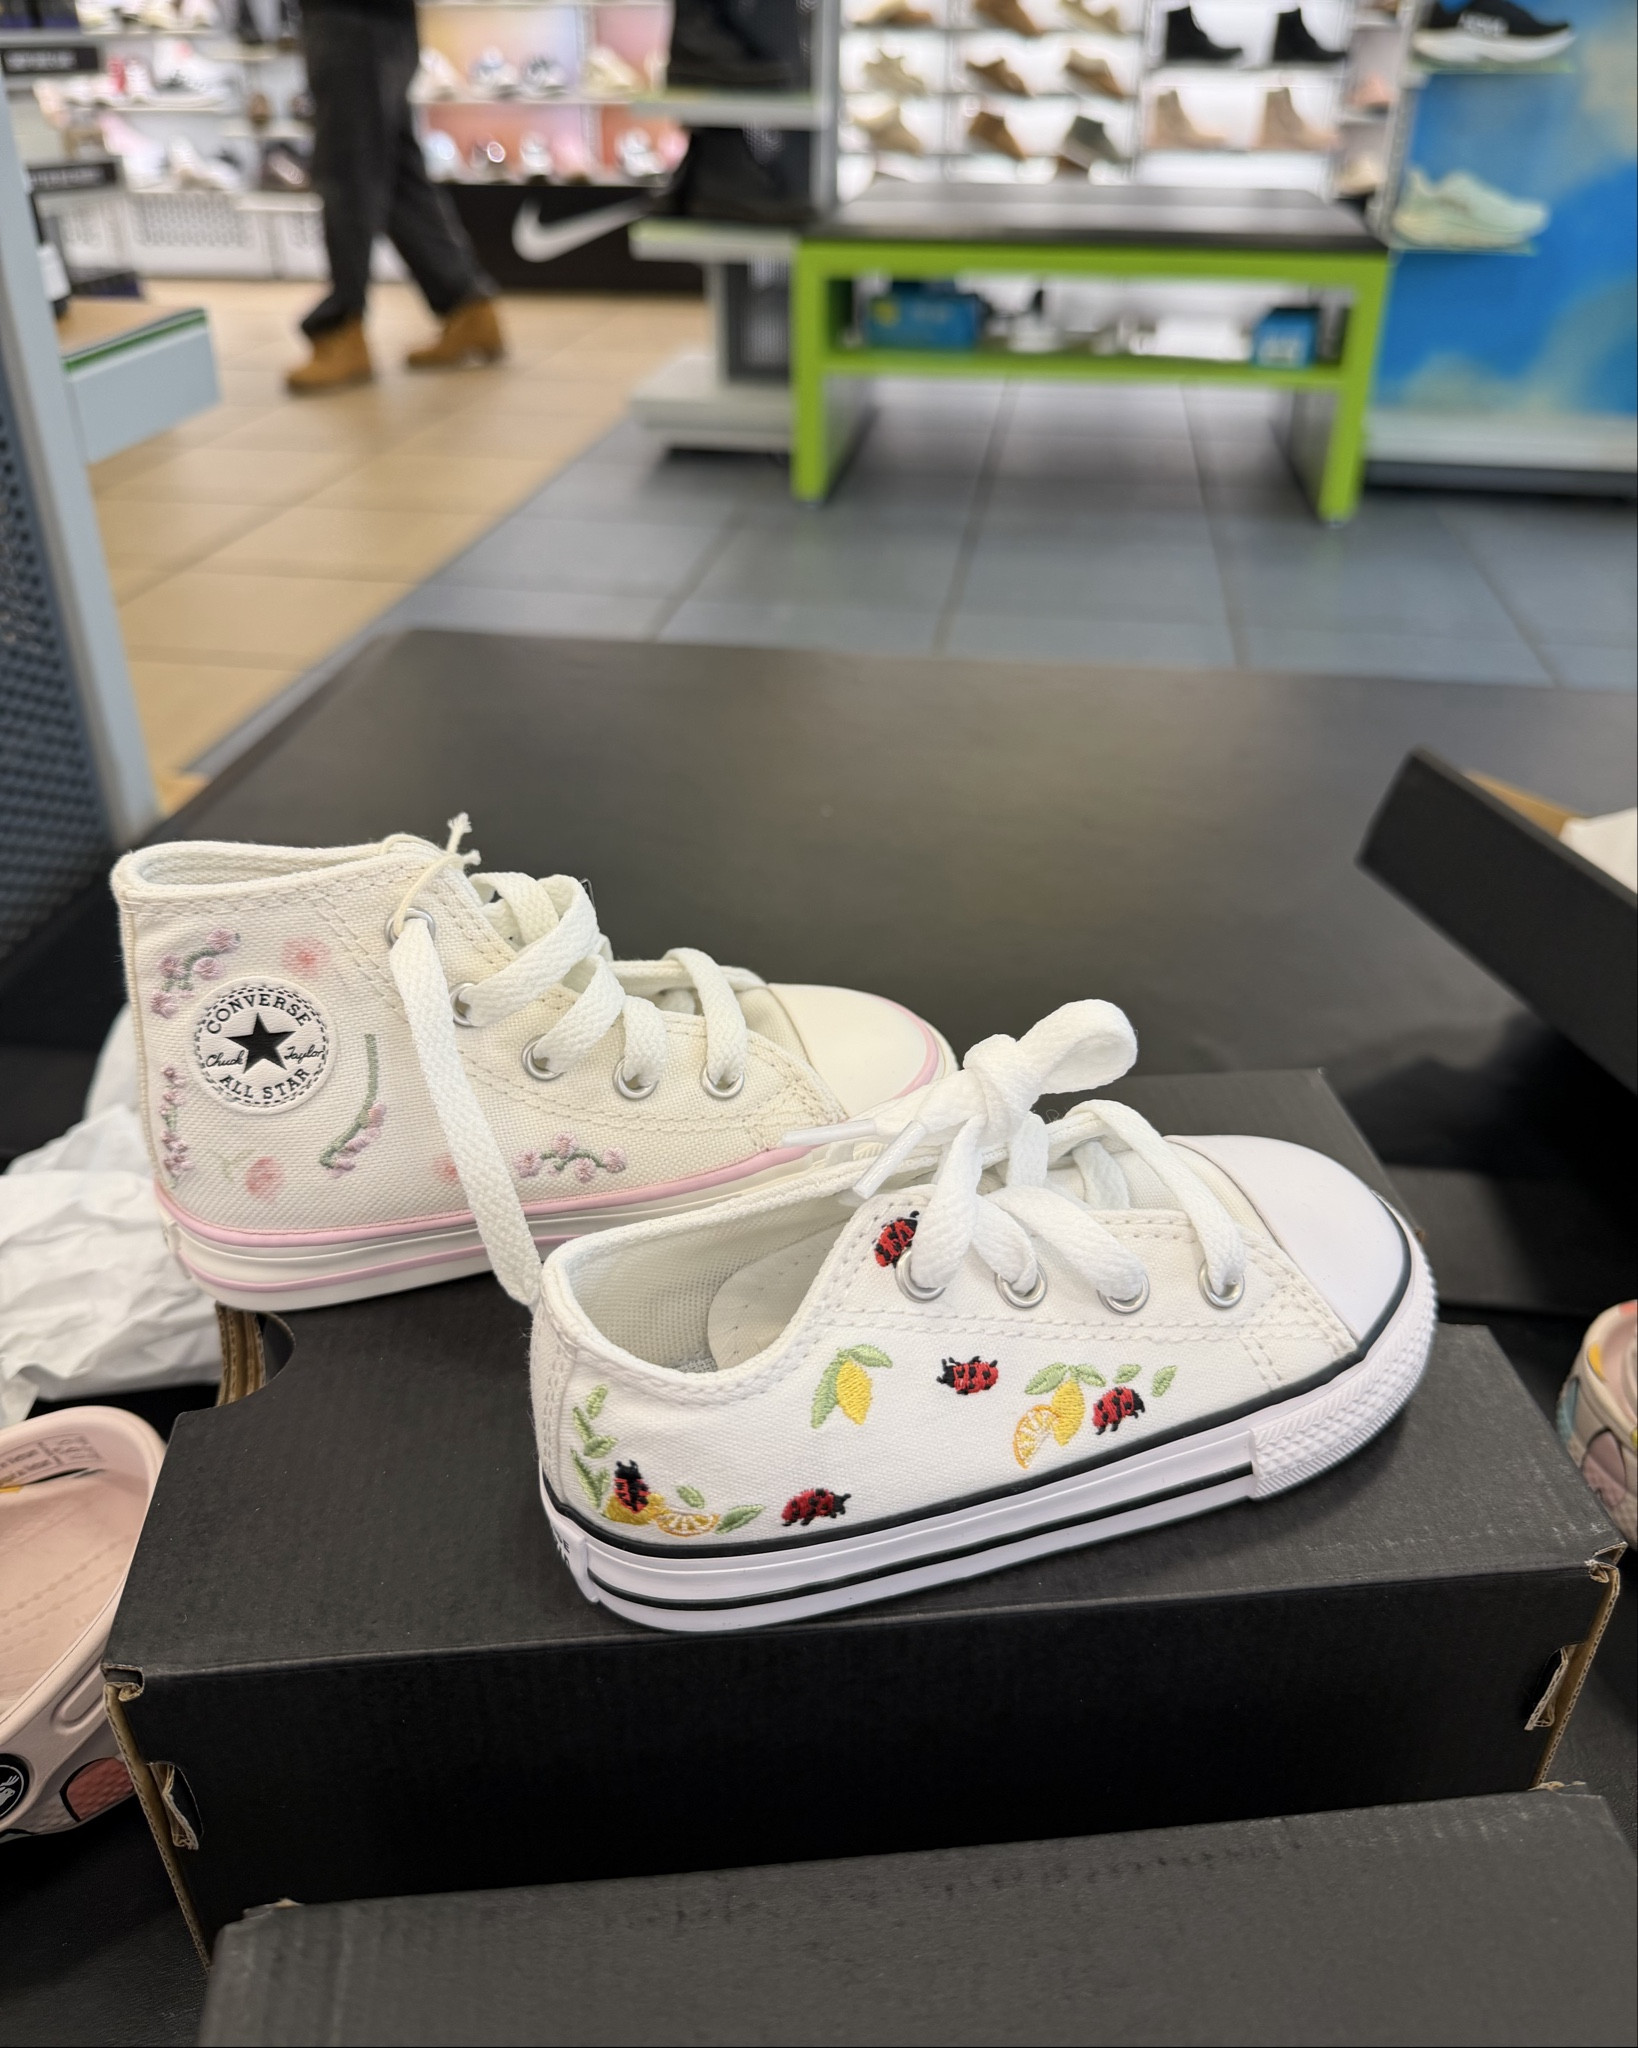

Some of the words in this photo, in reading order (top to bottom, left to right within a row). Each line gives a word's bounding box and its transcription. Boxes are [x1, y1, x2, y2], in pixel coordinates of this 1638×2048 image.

[206, 993, 311, 1034] CONVERSE
[205, 1050, 244, 1068] Chuck
[284, 1044, 323, 1064] Taylor
[219, 1074, 254, 1099] ALL
[262, 1068, 310, 1099] STAR
